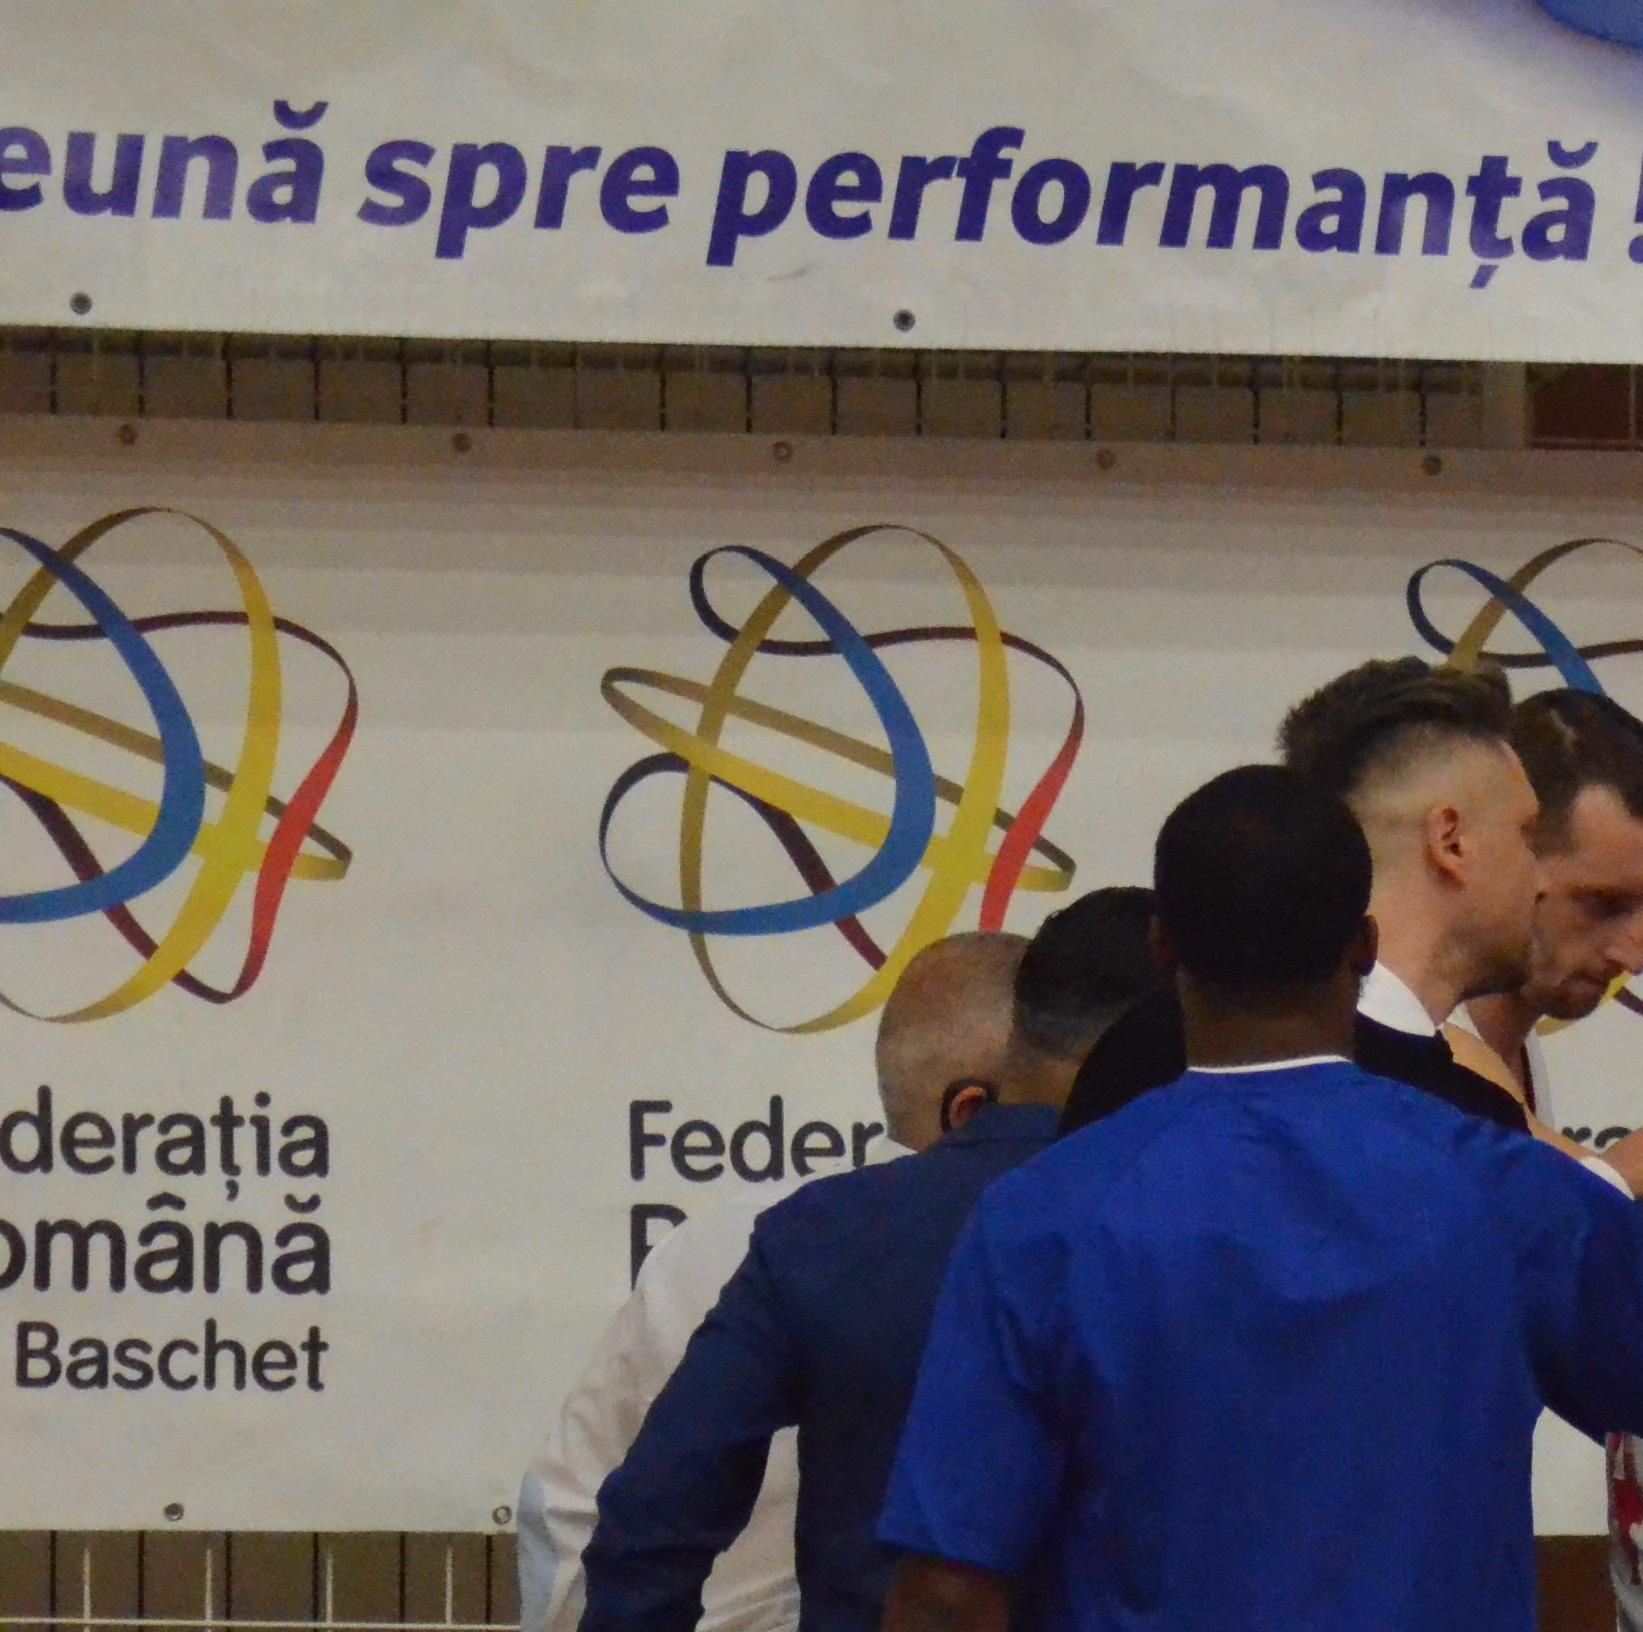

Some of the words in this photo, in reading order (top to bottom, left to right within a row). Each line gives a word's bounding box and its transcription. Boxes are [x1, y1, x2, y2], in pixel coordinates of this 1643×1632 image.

[356, 138, 681, 260] spre
[705, 125, 1599, 290] performanță
[14, 1317, 330, 1392] Baschet
